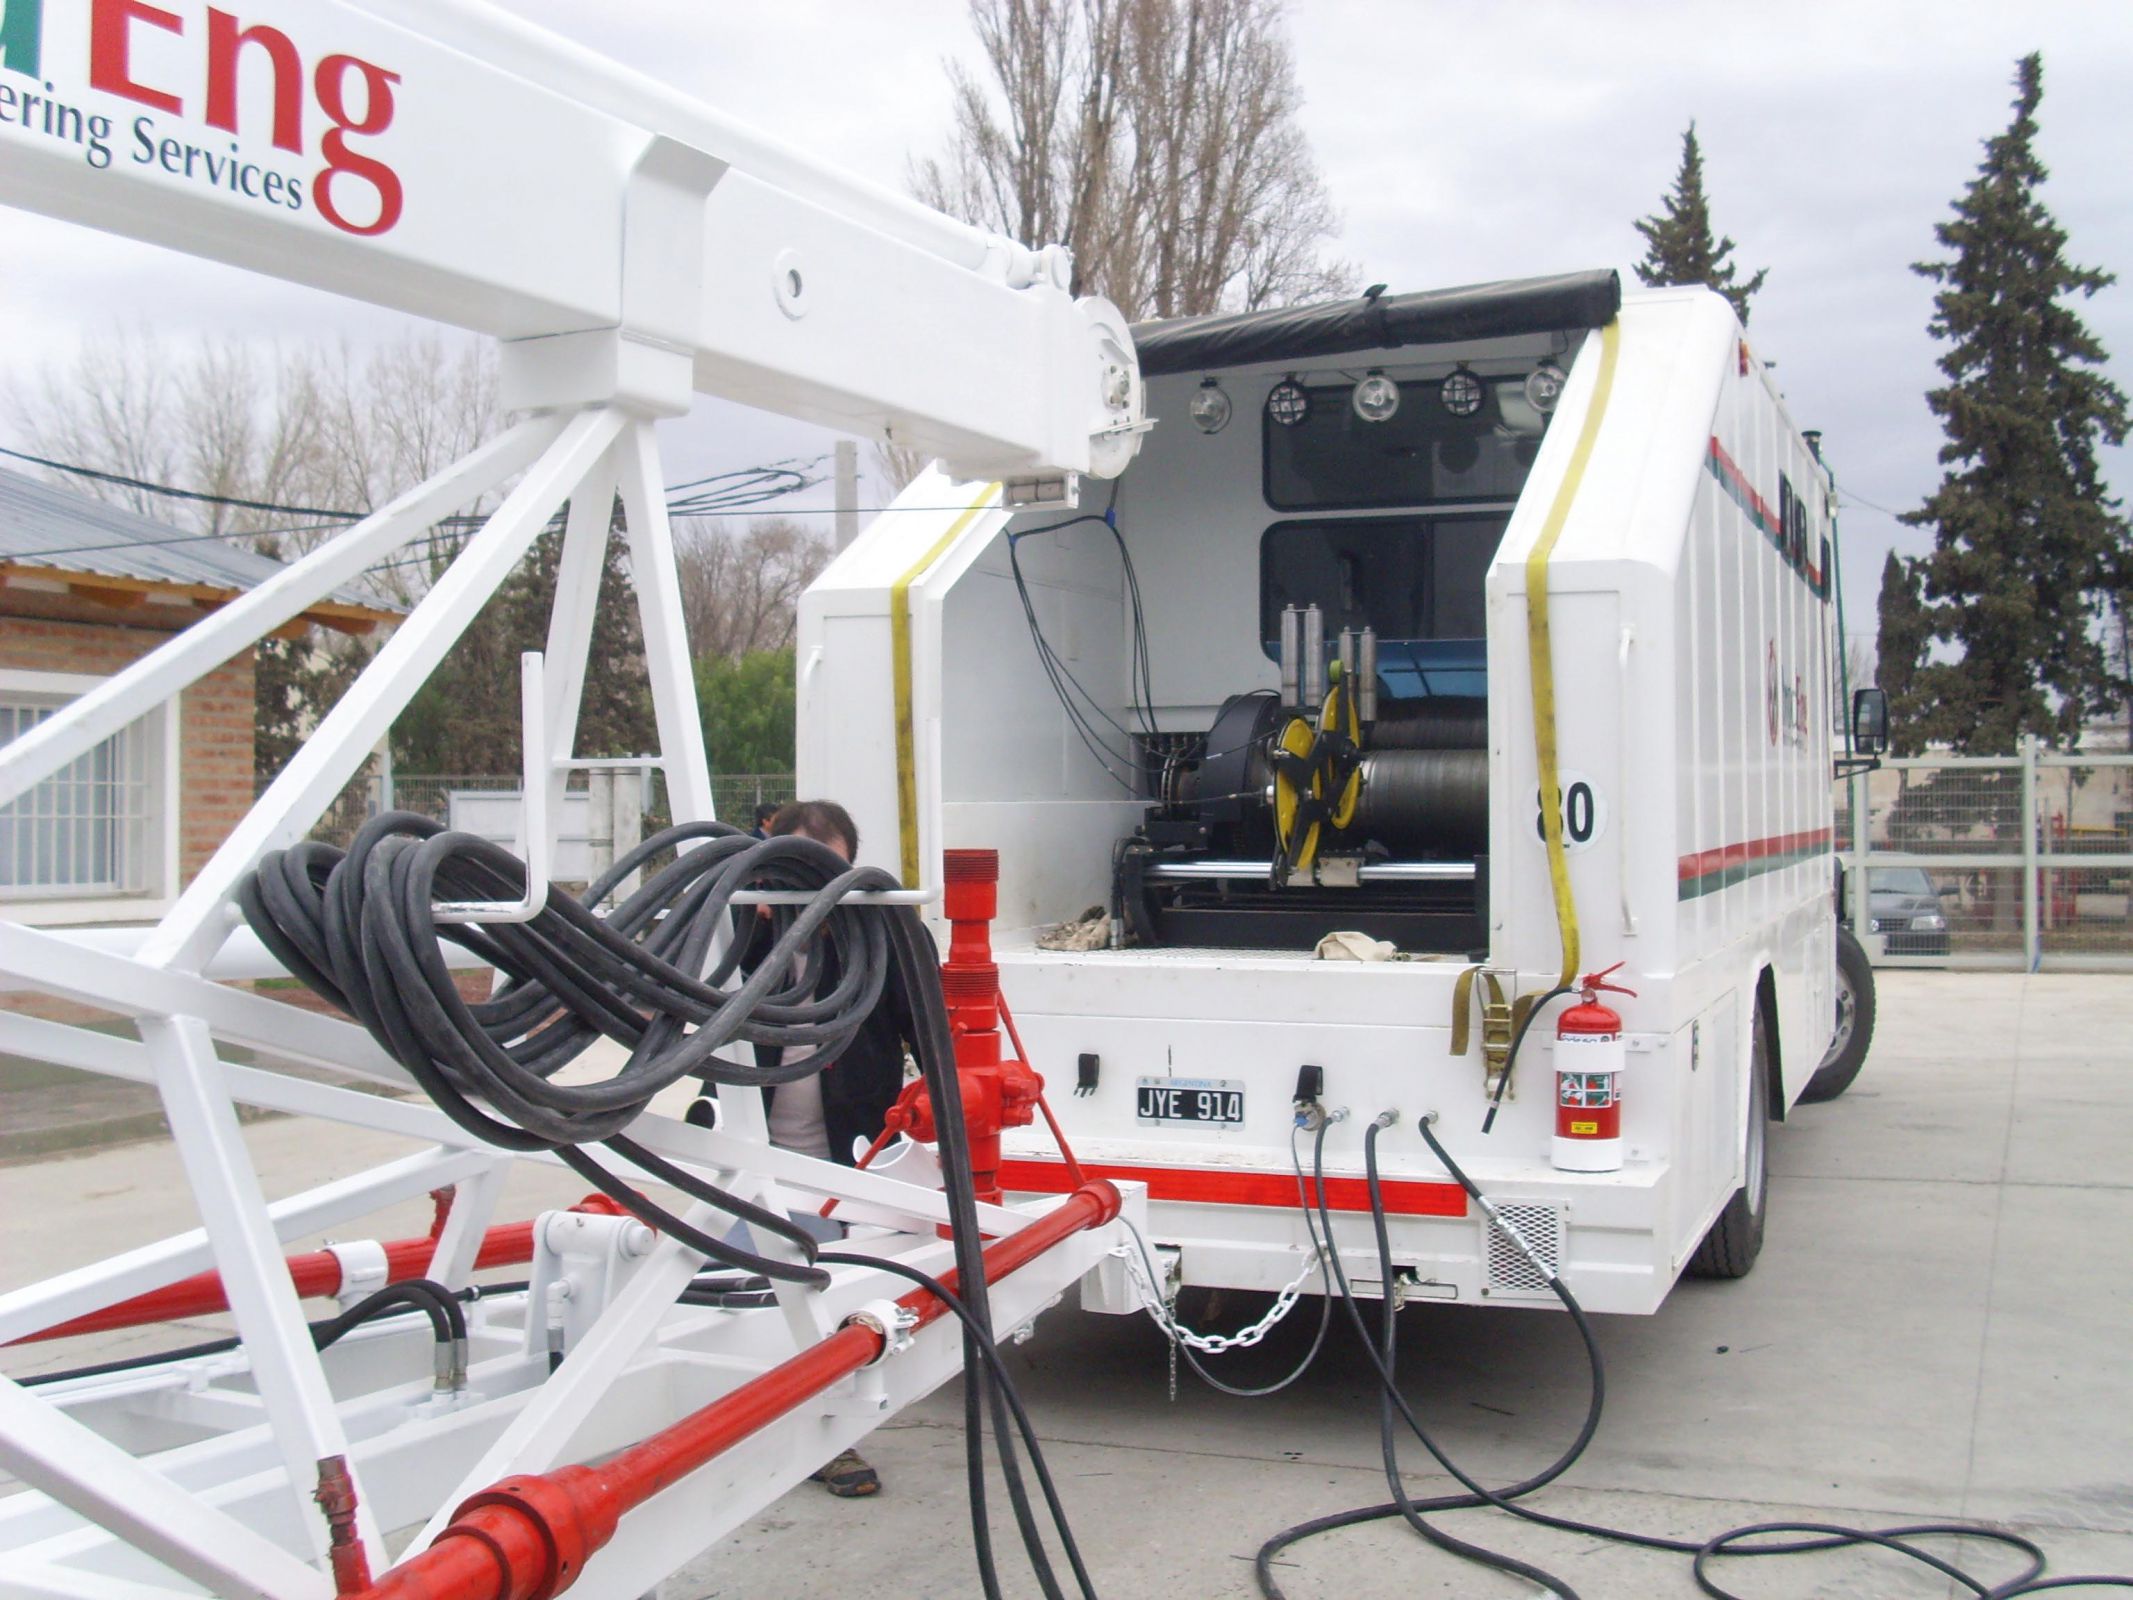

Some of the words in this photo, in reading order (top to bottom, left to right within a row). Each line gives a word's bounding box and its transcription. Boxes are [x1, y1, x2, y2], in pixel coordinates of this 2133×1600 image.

[131, 116, 303, 211] Services
[1140, 1089, 1182, 1118] JYE
[1197, 1092, 1240, 1121] 914
